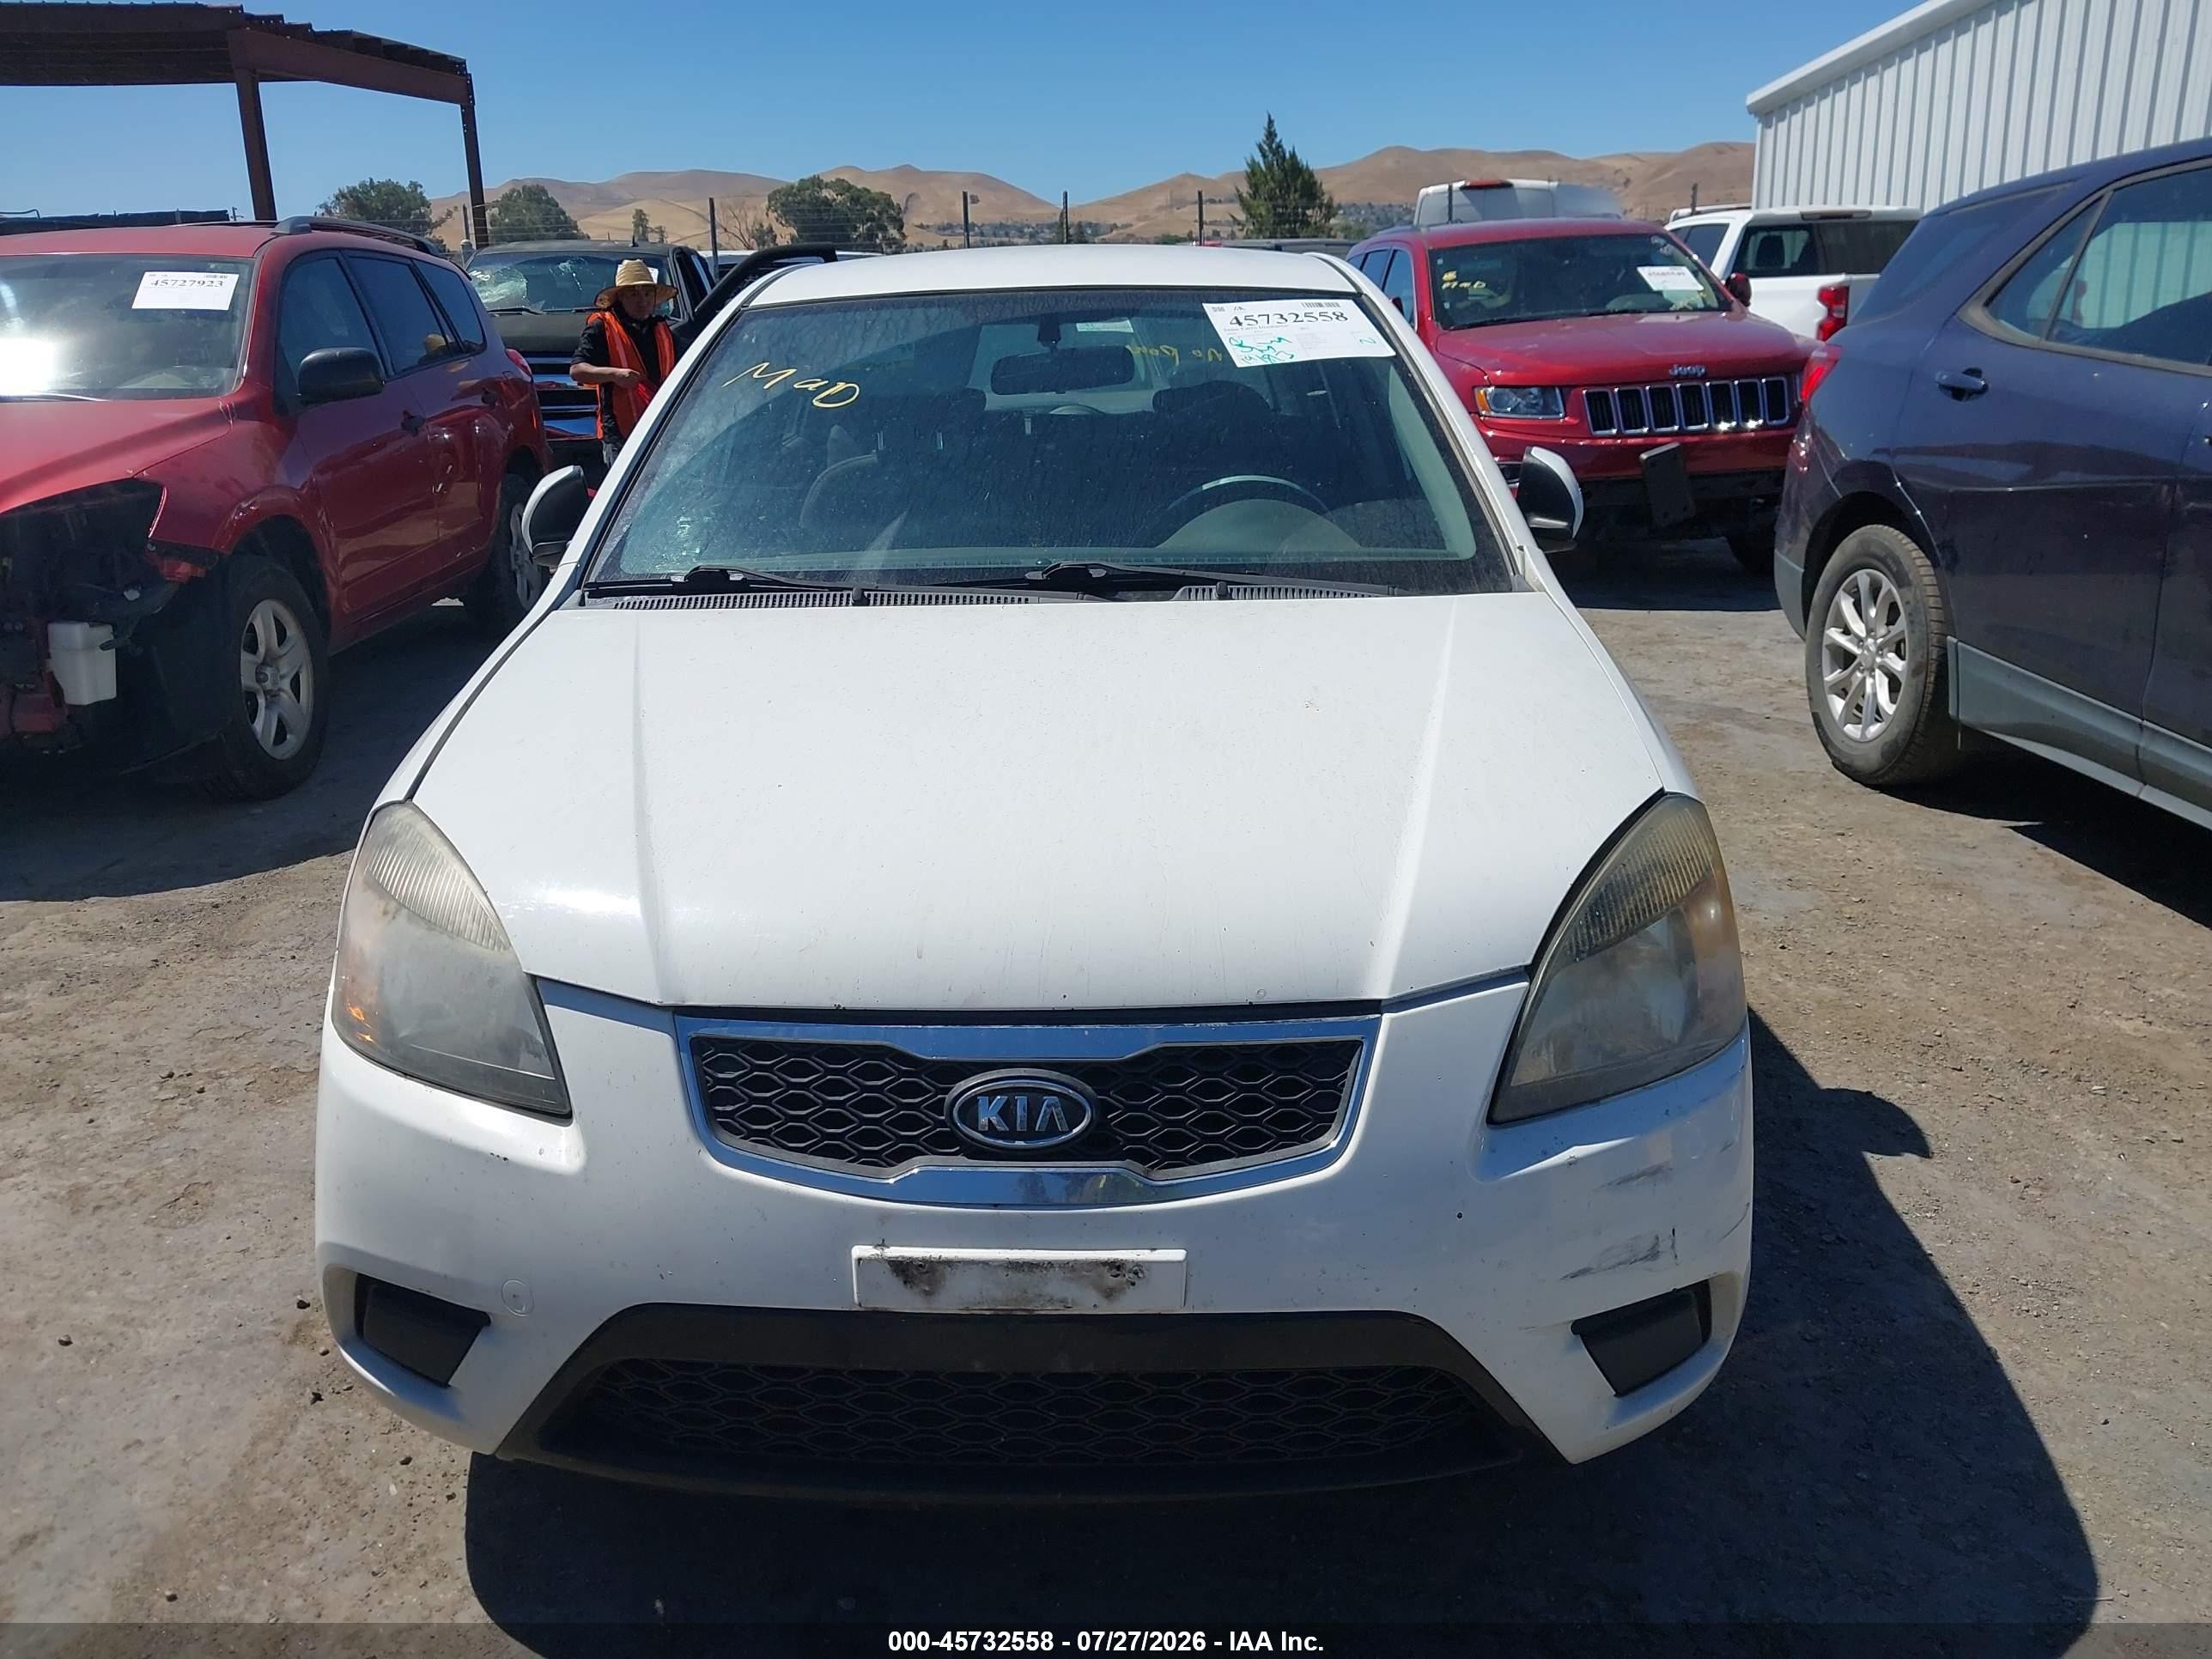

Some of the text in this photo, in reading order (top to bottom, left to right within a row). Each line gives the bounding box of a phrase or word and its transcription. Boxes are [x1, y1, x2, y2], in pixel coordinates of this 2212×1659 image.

[150, 279, 223, 288] 45727923
[1230, 312, 1348, 327] 45732558
[977, 1096, 1070, 1132] KIA
